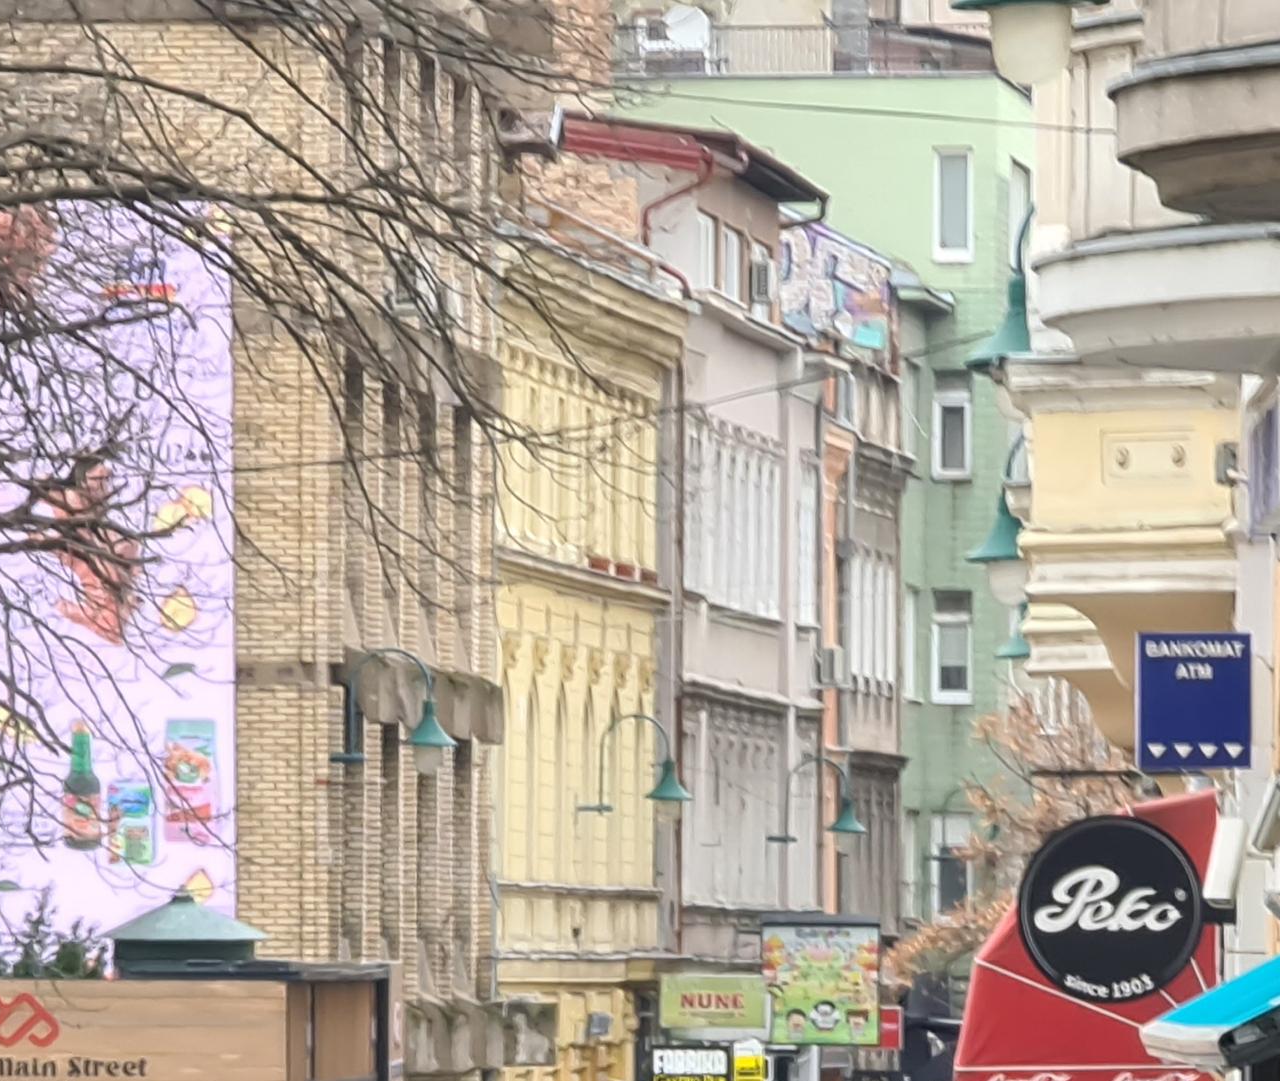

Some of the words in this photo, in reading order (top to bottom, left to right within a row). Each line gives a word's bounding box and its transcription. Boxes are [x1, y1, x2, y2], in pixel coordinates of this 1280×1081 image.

[1145, 640, 1245, 658] BANKOMAT
[1175, 662, 1213, 680] ATM
[1033, 864, 1183, 933] Peko
[1064, 974, 1110, 998] since
[68, 1056, 148, 1078] Street
